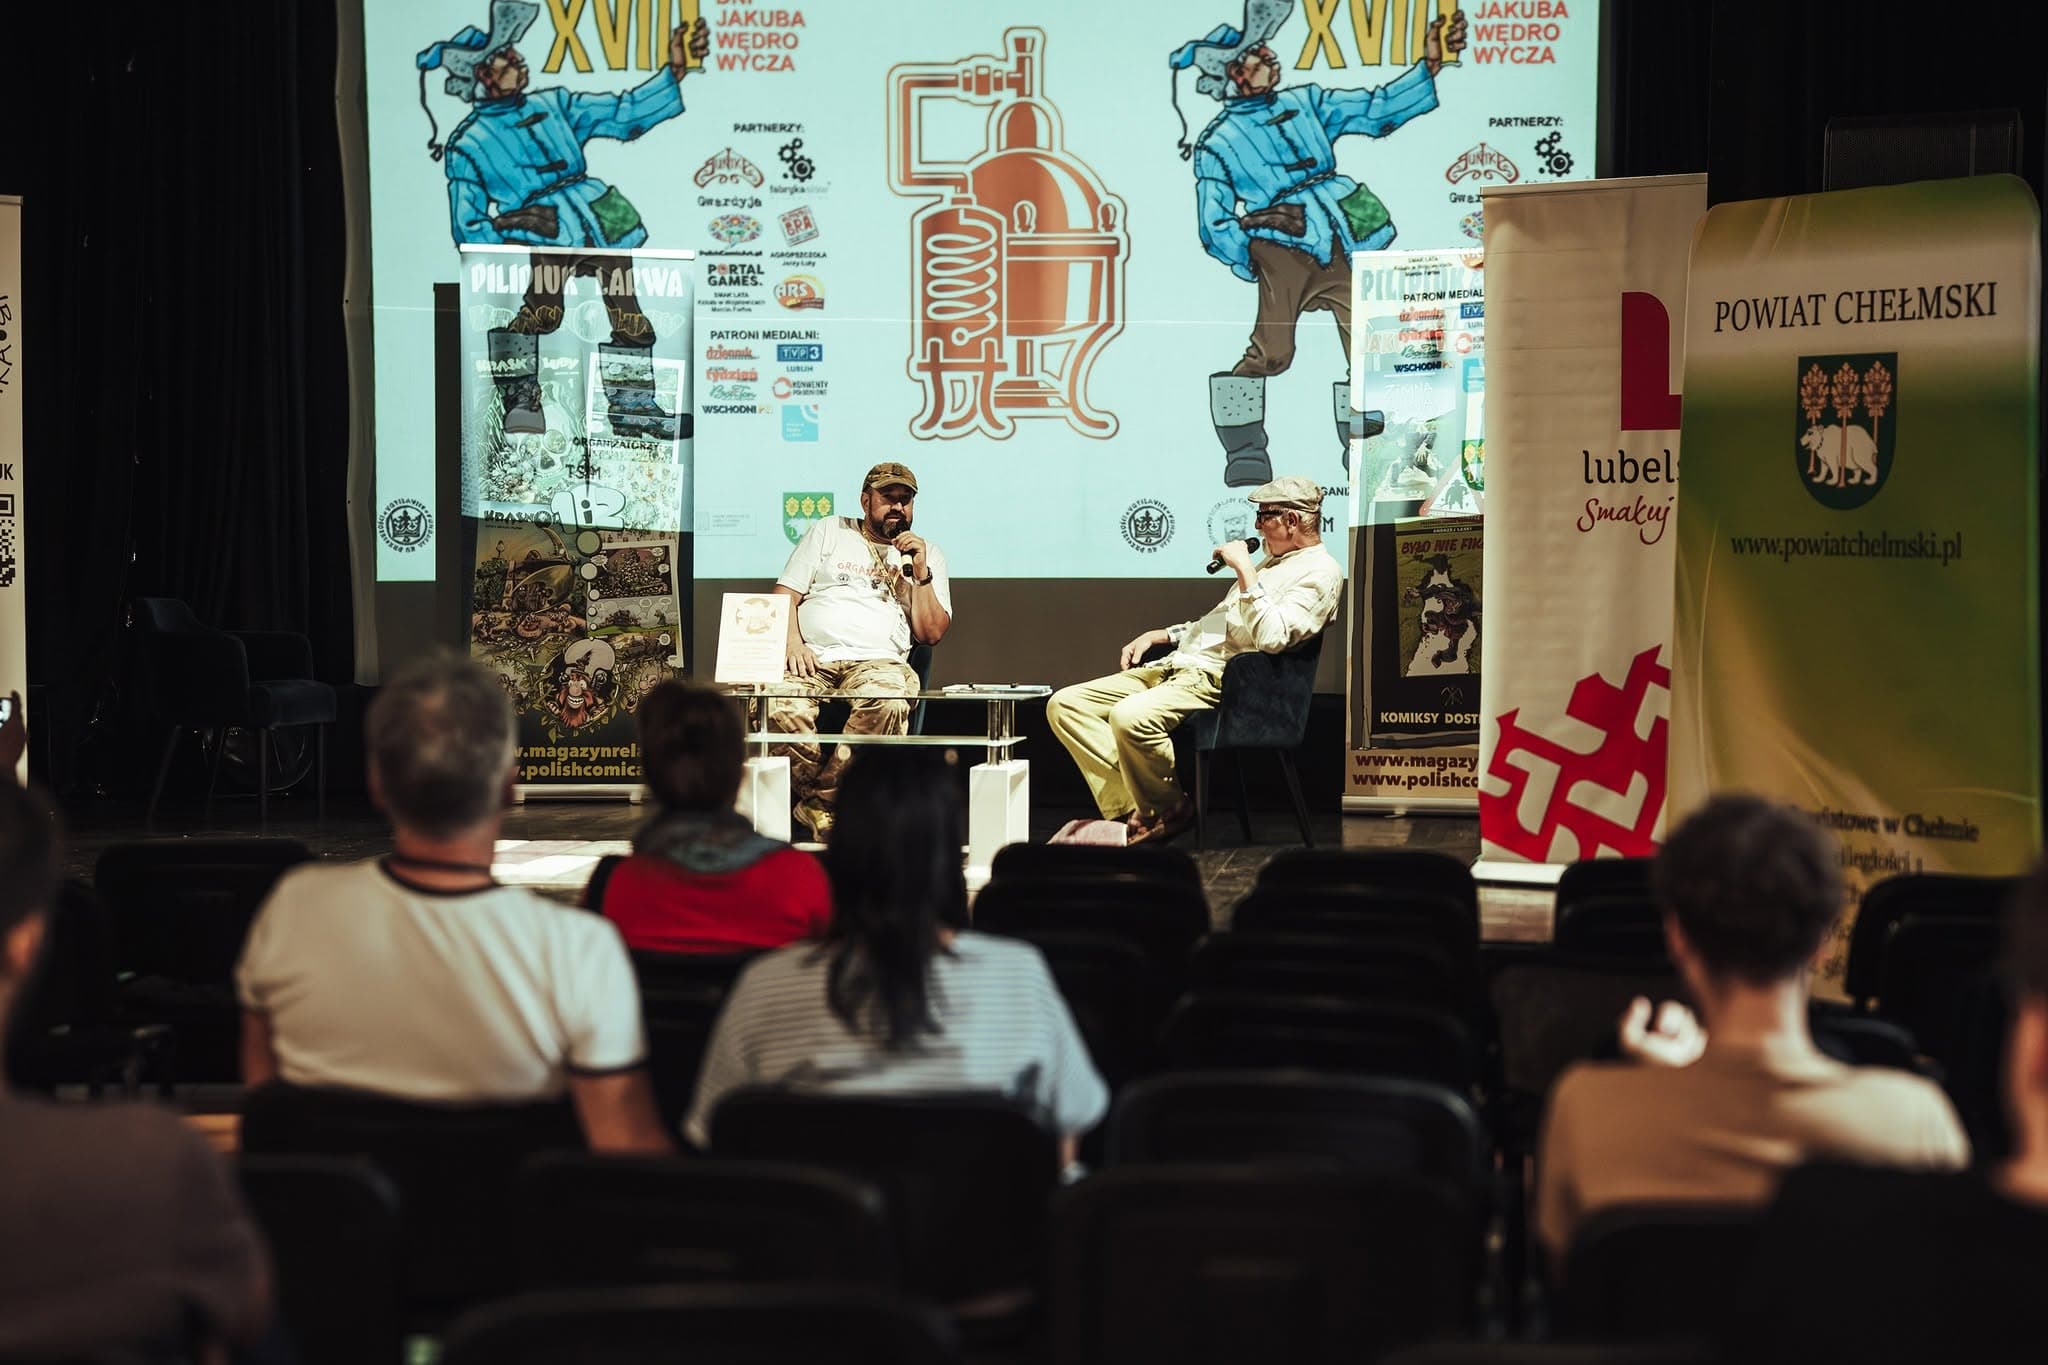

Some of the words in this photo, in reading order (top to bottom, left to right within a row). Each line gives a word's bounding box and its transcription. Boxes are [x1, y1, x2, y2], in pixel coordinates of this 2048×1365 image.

[1475, 0, 1569, 19] JAKUBA
[716, 10, 806, 28] JAKUBA
[716, 31, 799, 54] WĘDRO
[1475, 23, 1560, 46] WĘDRO
[716, 54, 795, 72] WYCZA
[1474, 46, 1556, 64] WYCZA
[733, 123, 805, 133] PARTNERZY:
[1488, 117, 1563, 128] PARTNERZY:
[708, 264, 764, 275] PORTAL
[708, 275, 763, 286] GAMES.
[1403, 291, 1446, 303] PATRONI
[1449, 288, 1484, 299] MEDIAL
[1713, 293, 1827, 333] POWIAT
[1834, 281, 1998, 325] CHEŁMSKI
[710, 330, 759, 340] PATRONI
[762, 330, 820, 340] MEDIALNI:
[1583, 449, 1680, 484] lubel
[1577, 495, 1675, 545] Smakuj
[1435, 538, 1457, 552] NIE
[1461, 537, 1483, 550] FIK
[1731, 530, 1963, 567] www.powiatchelmski.pl
[1381, 712, 1439, 724] KOMIKSY
[1445, 713, 1480, 724] DOST
[513, 743, 640, 762] .magazynrel
[1355, 755, 1479, 772] www.magazy
[1352, 772, 1479, 790] www.polishco
